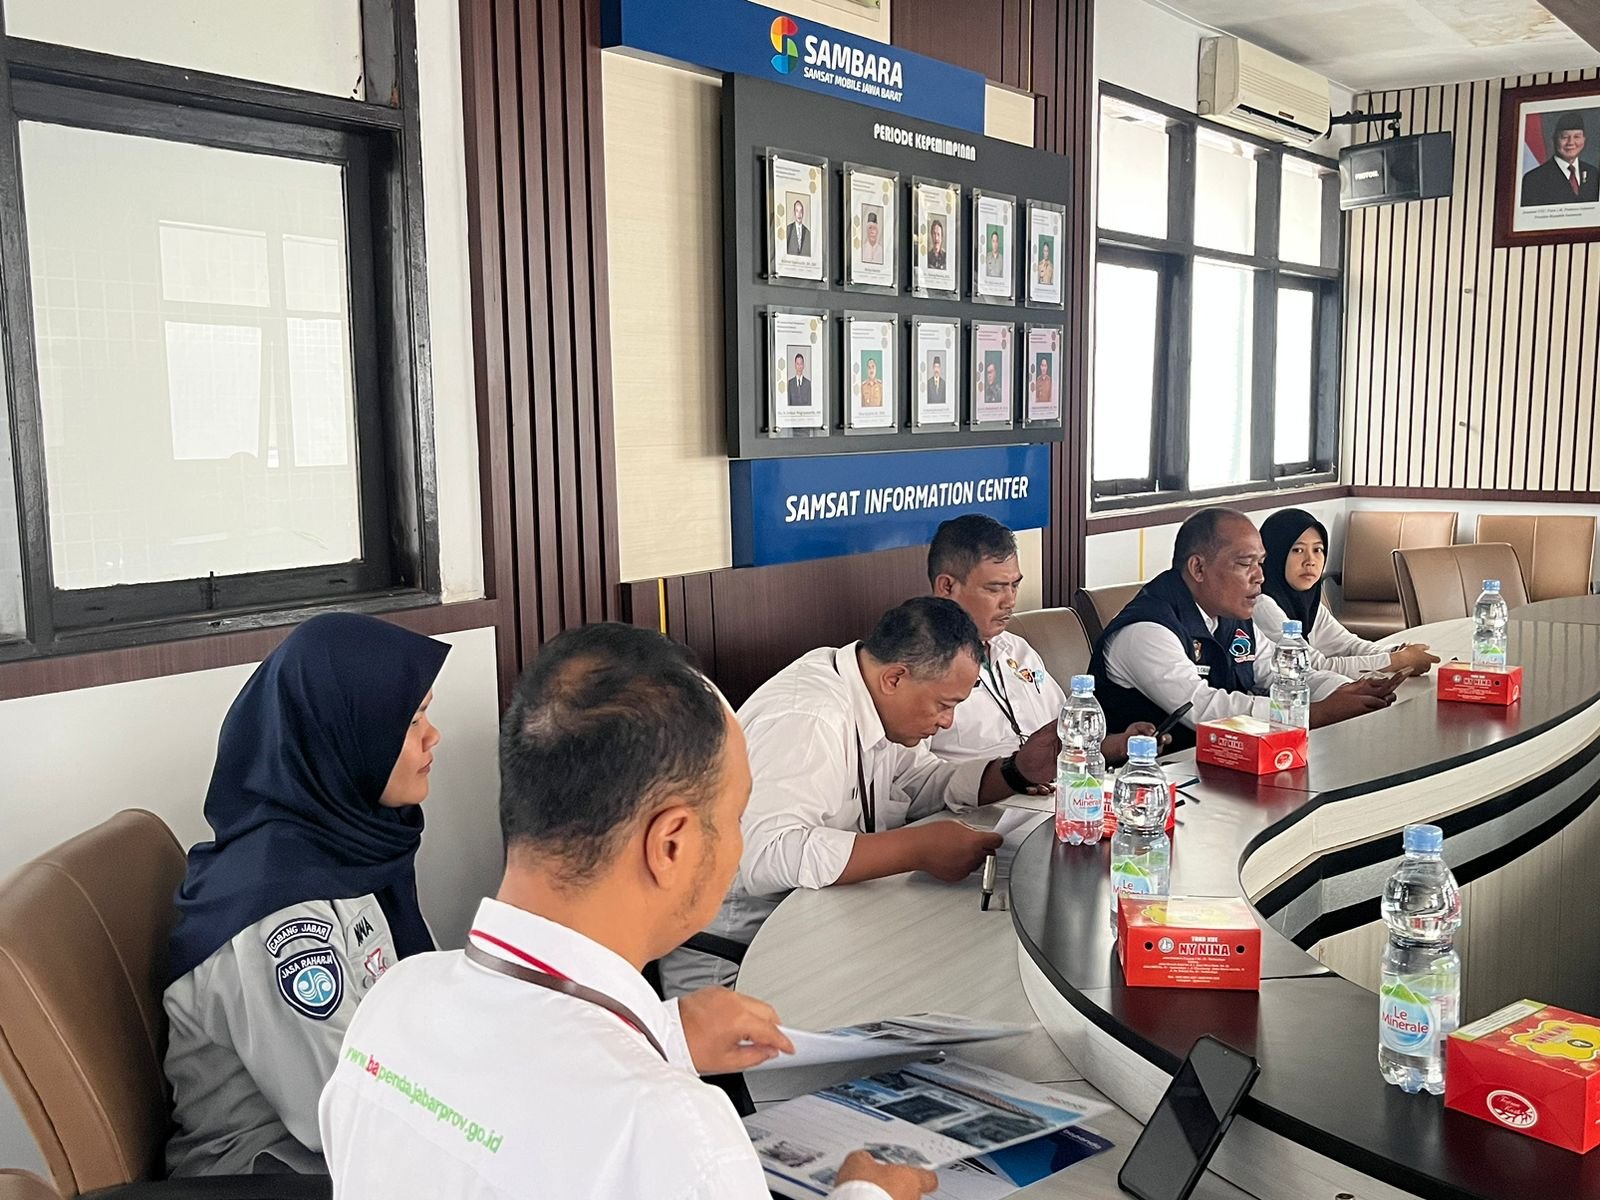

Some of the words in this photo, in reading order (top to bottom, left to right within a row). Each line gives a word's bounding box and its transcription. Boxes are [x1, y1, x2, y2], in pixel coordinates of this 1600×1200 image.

[804, 35, 903, 89] SAMBARA
[803, 66, 834, 84] SAMSAT
[834, 75, 861, 91] MOBILE
[862, 82, 880, 97] JAWA
[881, 88, 903, 103] BARAT
[873, 123, 914, 148] PERIODE
[914, 133, 977, 161] KEPEMIMPINAN
[785, 490, 861, 523] SAMSAT
[864, 481, 974, 514] INFORMATION
[976, 475, 1029, 503] CENTER
[1122, 879, 1134, 890] Le
[270, 925, 298, 949] CABANG
[301, 924, 327, 936] JABAR
[1179, 943, 1197, 956] NY
[1197, 943, 1231, 957] NINA
[281, 962, 301, 979] JASA
[300, 955, 334, 969] RAHARJA
[1382, 1011, 1430, 1034] Minerale
[1393, 1006, 1408, 1020] Le
